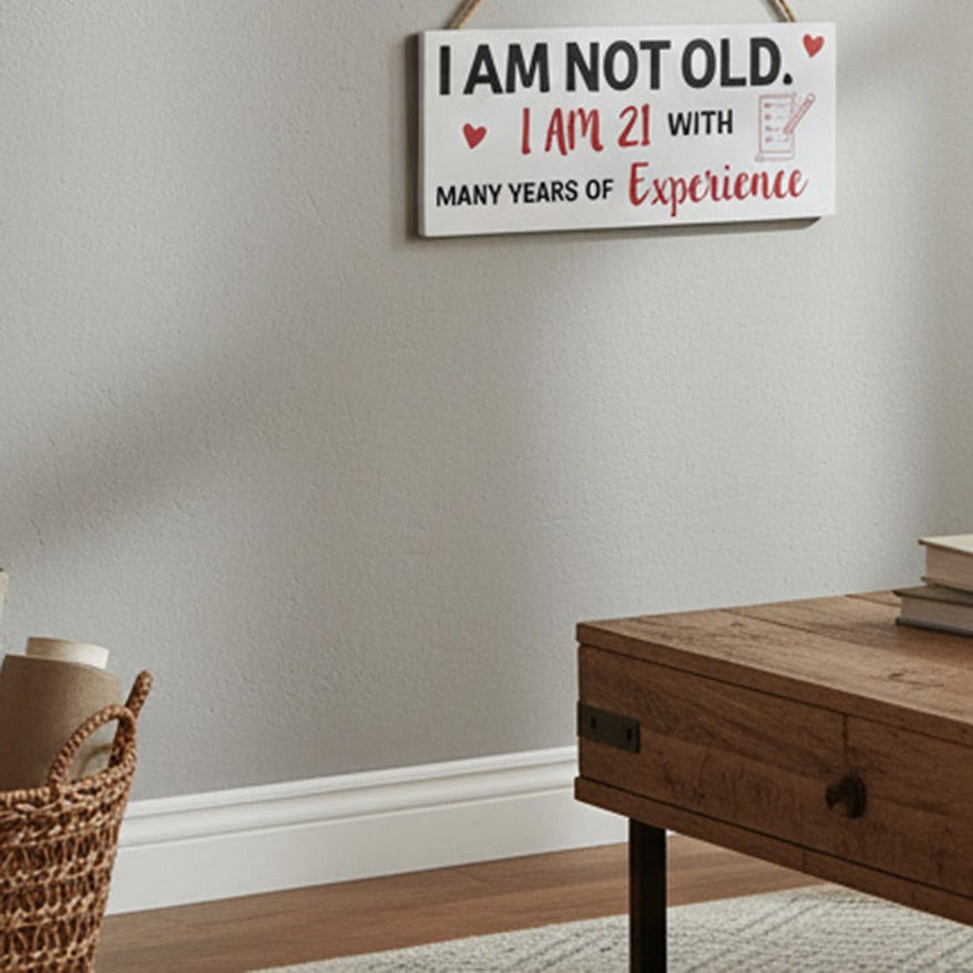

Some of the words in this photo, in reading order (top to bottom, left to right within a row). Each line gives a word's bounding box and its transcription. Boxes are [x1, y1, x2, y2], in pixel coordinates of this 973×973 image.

[439, 45, 451, 95] I
[463, 43, 550, 95] AM
[566, 40, 671, 92] NOT
[682, 37, 793, 89] OLD.
[521, 108, 532, 155] I
[545, 108, 604, 156] AM
[618, 104, 650, 147] 21
[668, 109, 732, 136] WITH
[437, 184, 502, 206] MANY
[508, 180, 578, 203] YEARS
[586, 179, 613, 200] OF
[629, 162, 808, 217] Experience
